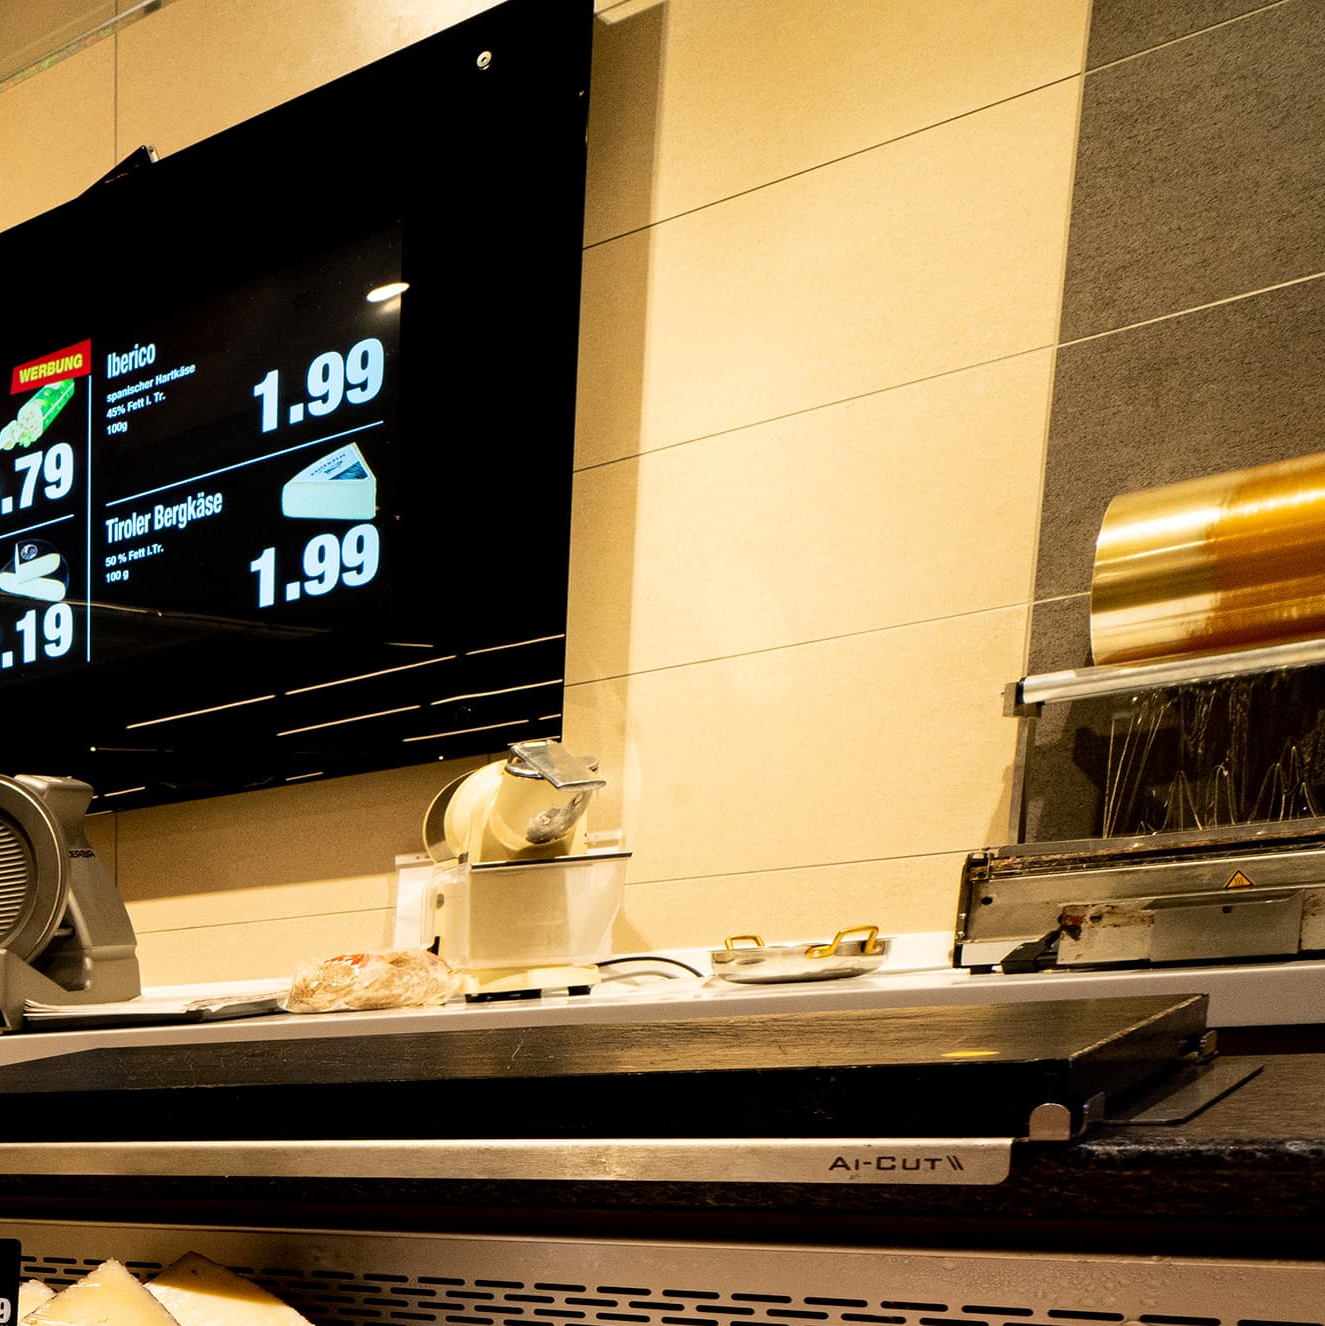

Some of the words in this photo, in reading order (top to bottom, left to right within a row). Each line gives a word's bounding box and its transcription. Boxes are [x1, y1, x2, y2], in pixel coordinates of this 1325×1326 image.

[19, 354, 83, 383] WERBUNG
[107, 343, 156, 379] Iberico
[107, 379, 154, 404] spanischer
[155, 362, 196, 386] Hartkäse
[253, 338, 385, 434] 1.99
[107, 420, 128, 436] 100g
[105, 510, 151, 544] Tiroler
[154, 492, 223, 531] Bergkäse
[250, 523, 380, 609] 1.99
